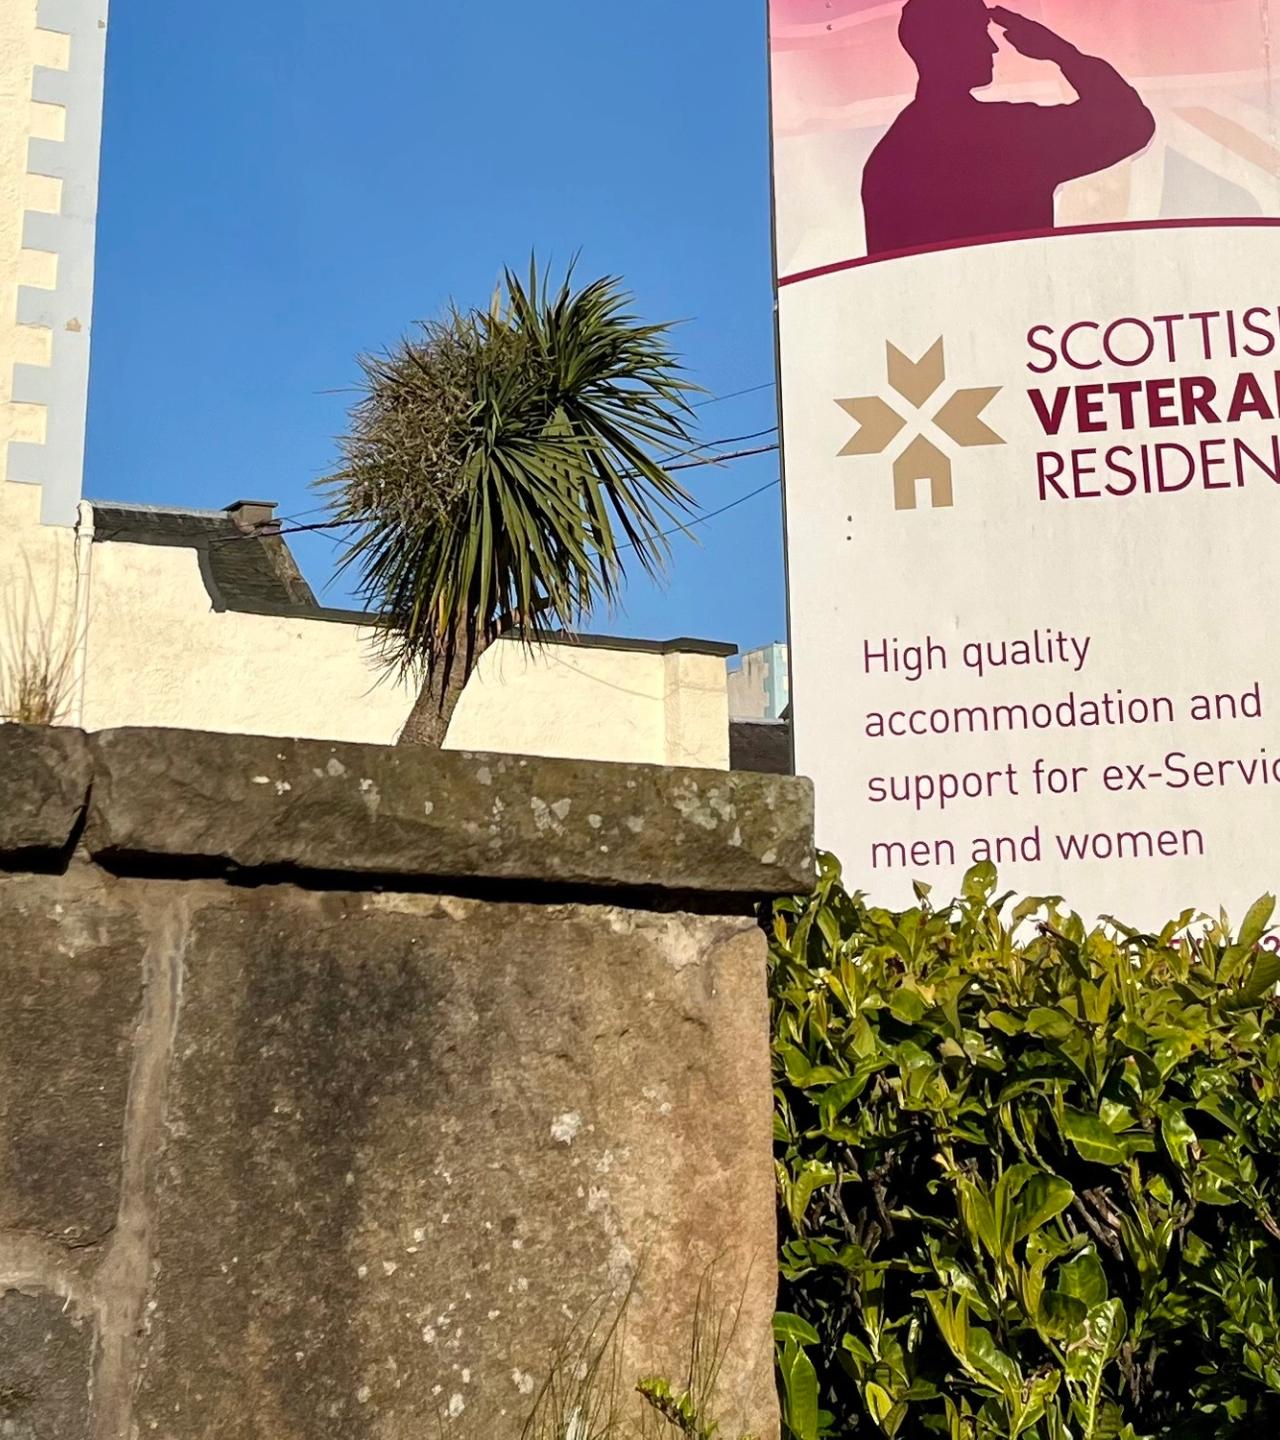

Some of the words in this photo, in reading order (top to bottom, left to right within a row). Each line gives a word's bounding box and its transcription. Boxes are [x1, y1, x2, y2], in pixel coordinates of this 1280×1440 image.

[863, 635, 947, 682] High
[962, 628, 1092, 677] quality
[865, 690, 1174, 737] accommodation
[1190, 682, 1262, 721] and
[867, 763, 1019, 811] support
[1032, 758, 1089, 795] for
[871, 839, 956, 869] men
[971, 825, 1041, 866] and
[1055, 828, 1205, 860] women
